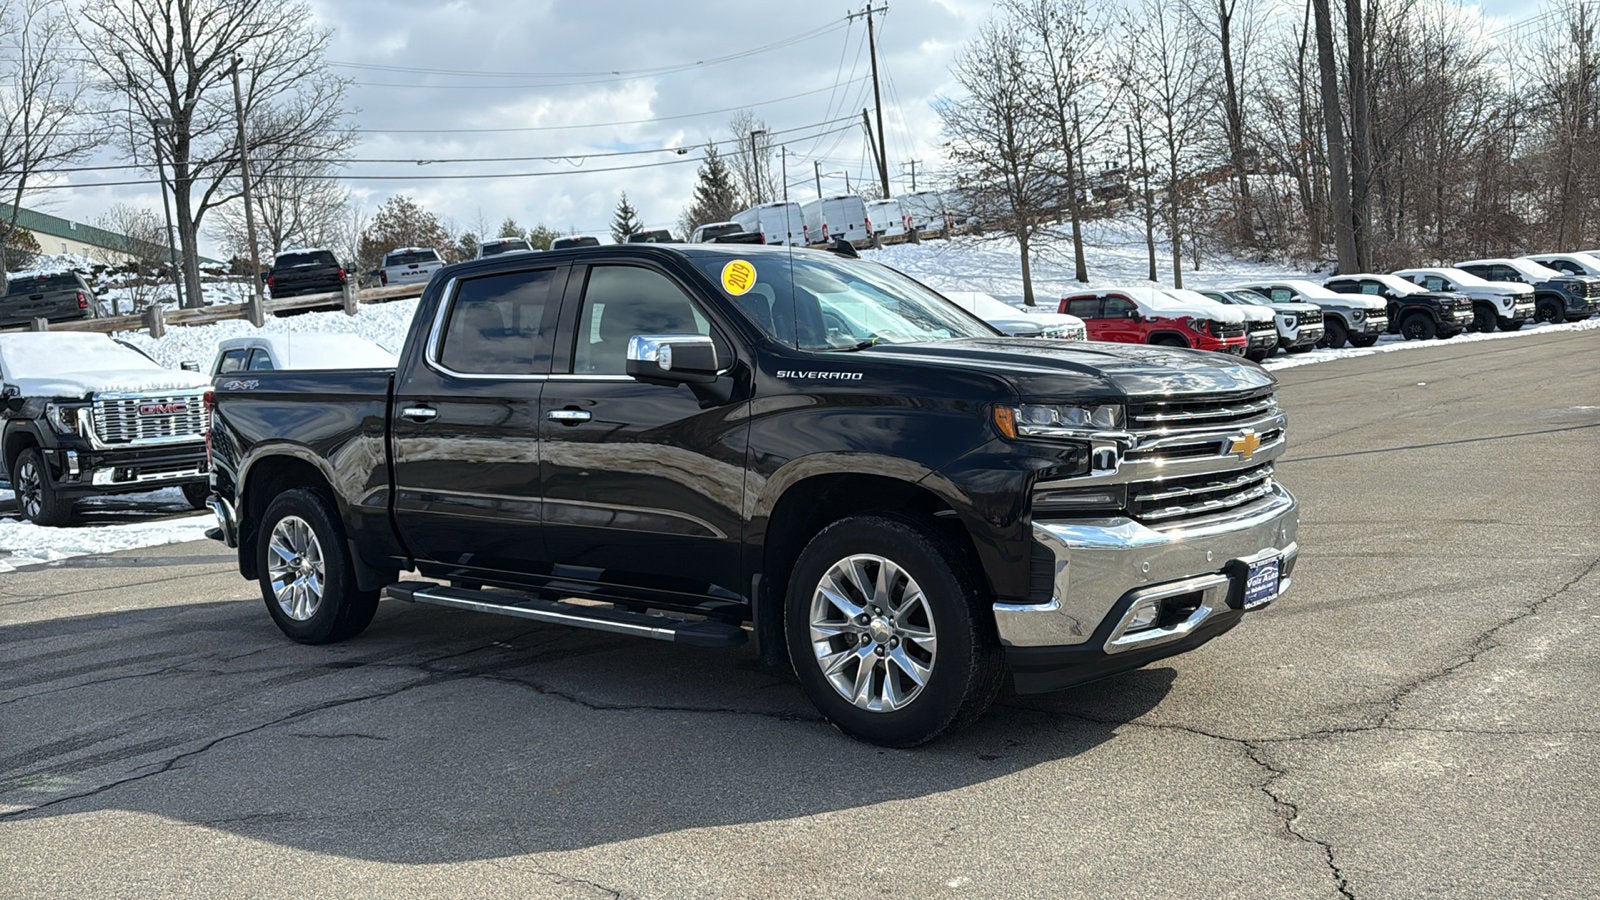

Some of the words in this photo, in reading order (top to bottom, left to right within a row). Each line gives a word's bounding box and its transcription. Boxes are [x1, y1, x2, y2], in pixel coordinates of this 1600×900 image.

[728, 263, 750, 290] 2019
[776, 370, 863, 380] SILVERADO
[141, 403, 187, 415] GMC
[1262, 571, 1279, 583] Auto
